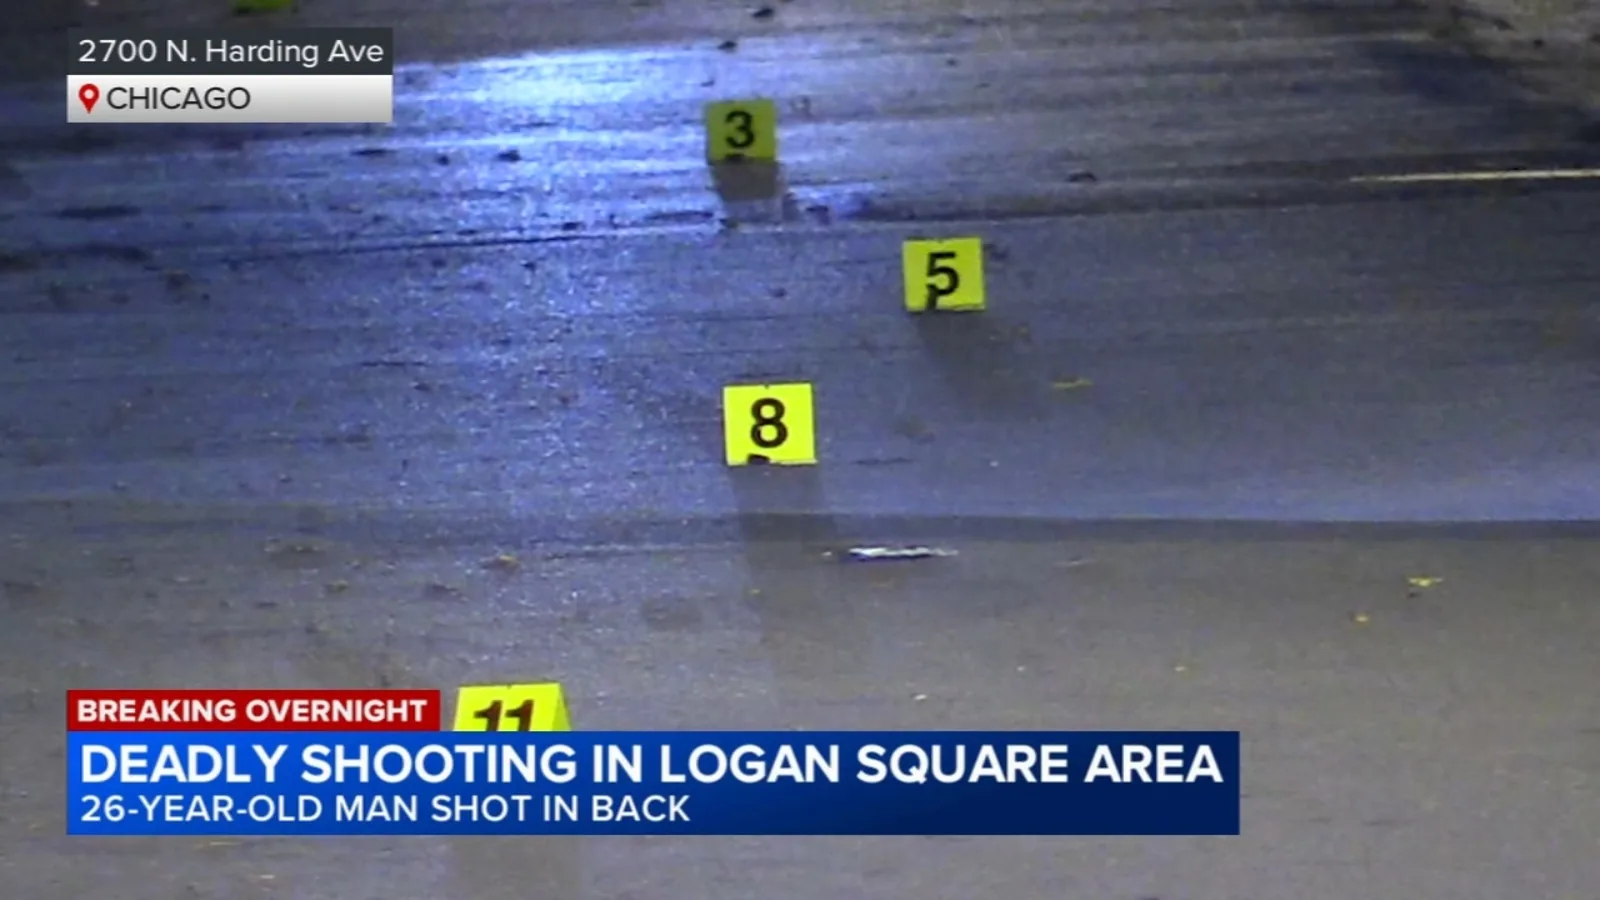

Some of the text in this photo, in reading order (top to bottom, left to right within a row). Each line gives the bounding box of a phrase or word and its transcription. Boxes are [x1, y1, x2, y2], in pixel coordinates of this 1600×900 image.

[723, 110, 756, 149] 3
[925, 251, 960, 297] 5
[750, 398, 788, 449] 8
[473, 699, 534, 731] 11
